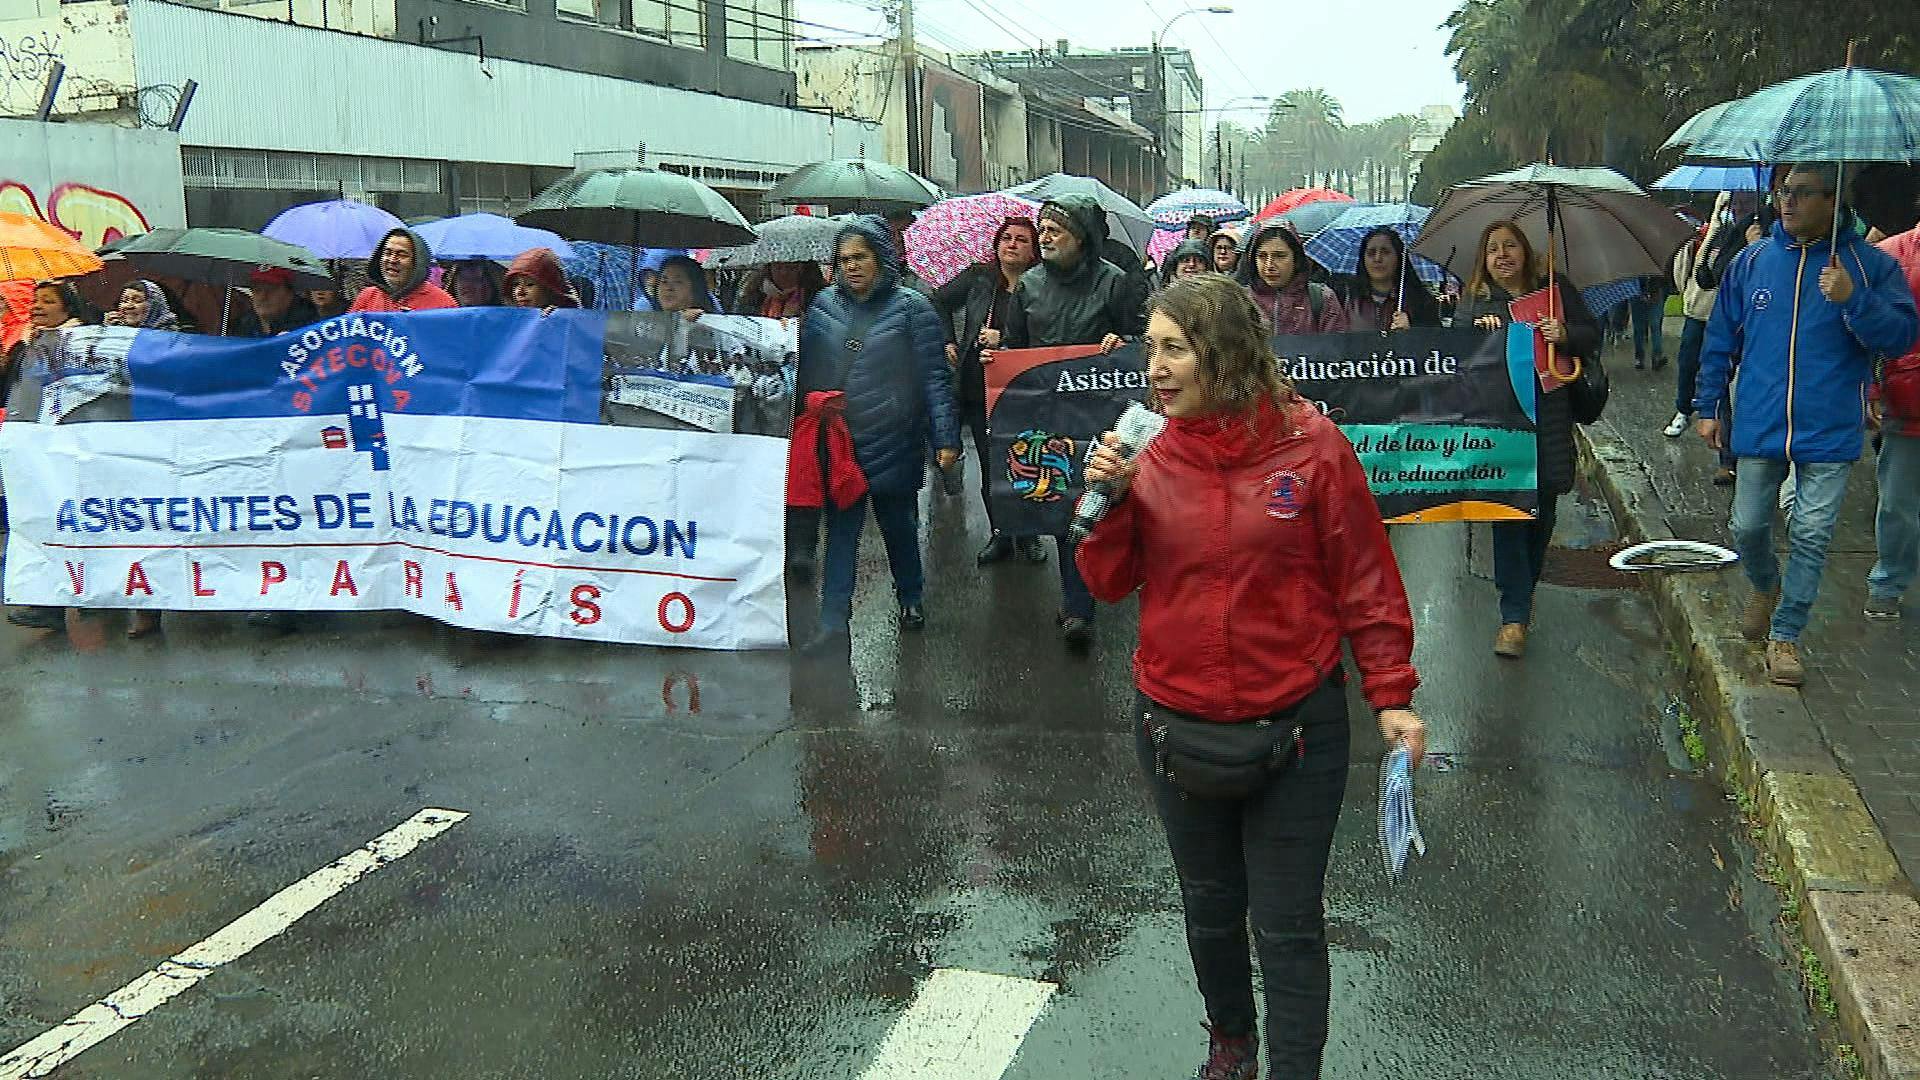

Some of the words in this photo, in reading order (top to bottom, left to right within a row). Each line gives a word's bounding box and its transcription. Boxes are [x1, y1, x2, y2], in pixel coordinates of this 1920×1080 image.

[280, 317, 425, 381] ASOCIACIÓN
[1056, 366, 1148, 392] Asiste
[1278, 351, 1417, 380] Educación
[1424, 350, 1457, 375] de
[1376, 434, 1400, 453] de
[1405, 433, 1437, 451] las
[1441, 436, 1459, 458] y
[1463, 433, 1494, 450] los
[1371, 465, 1394, 484] la
[56, 493, 301, 533] ASISTENTES
[313, 492, 375, 530] DE
[387, 490, 424, 533] LA
[427, 498, 698, 560] EDUCACION
